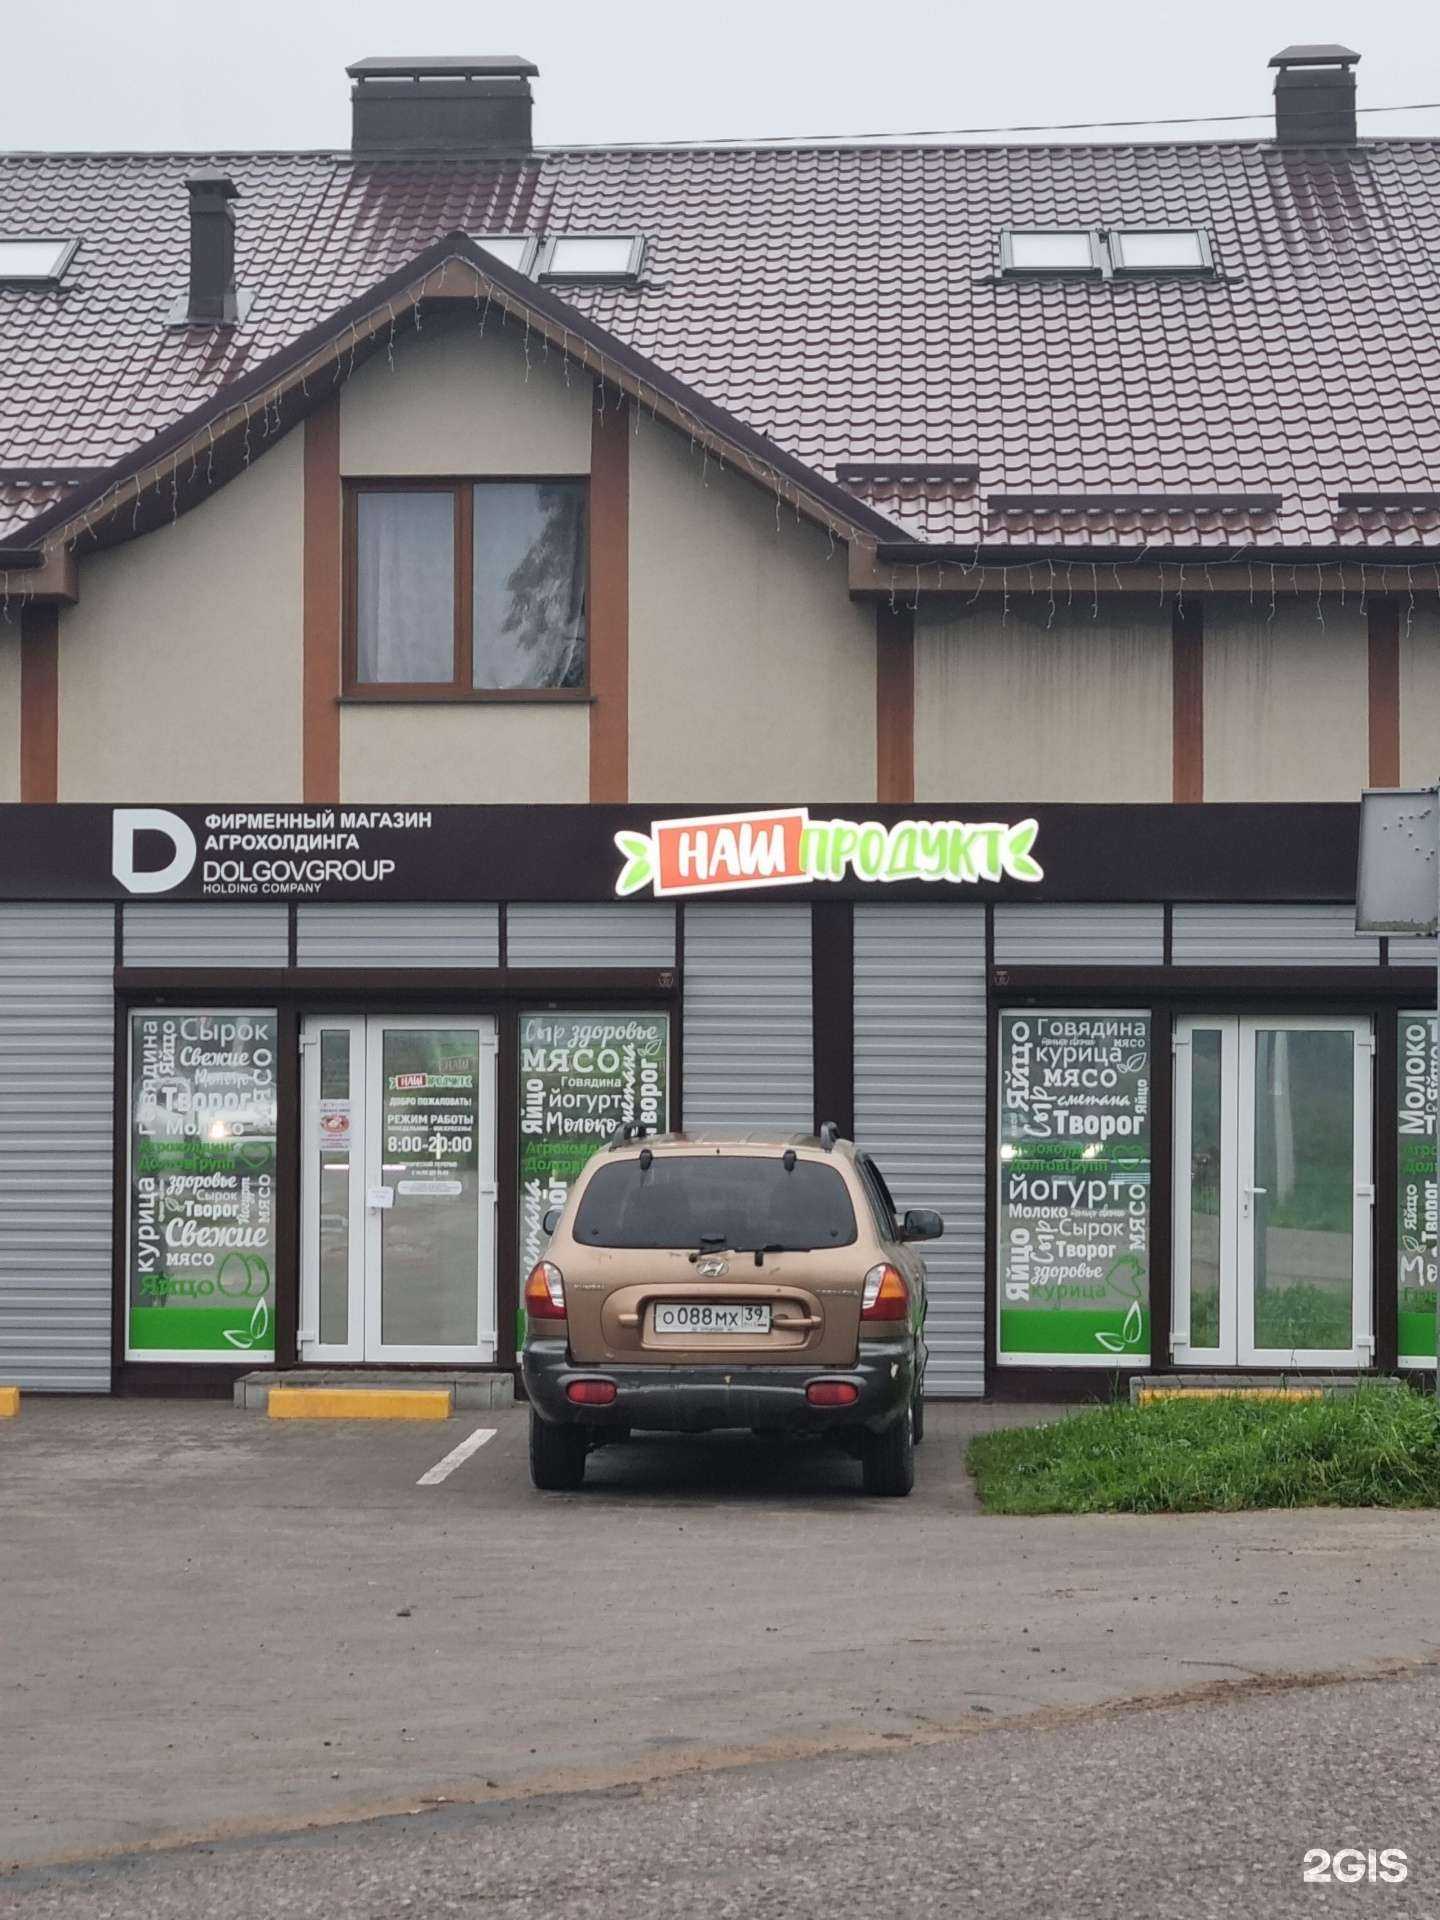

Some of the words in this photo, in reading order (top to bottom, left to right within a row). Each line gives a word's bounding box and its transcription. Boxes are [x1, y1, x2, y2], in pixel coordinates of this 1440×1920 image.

[205, 809, 335, 829] ФИРМЕННЫЙ
[340, 811, 432, 829] МАГАЗИН
[204, 834, 360, 853] АГРОХОЛДИНГА
[677, 822, 787, 881] НАШ
[799, 819, 1009, 883] ПРОДУКТ
[203, 859, 396, 883] DOLGOVGROUP
[203, 883, 259, 894] HOLDING
[262, 883, 322, 894] COMPANY
[180, 1018, 269, 1047] Сырок
[526, 1019, 565, 1046] Сыр
[567, 1021, 658, 1048] здоровье
[1037, 1019, 1146, 1039] Говядина
[1114, 1038, 1146, 1048] мясо
[180, 1046, 250, 1067] Свежие
[1004, 1021, 1033, 1112] Яйцо
[1036, 1046, 1122, 1068] курица
[561, 1076, 621, 1088] Говядина
[621, 1041, 637, 1125] метана
[1399, 1024, 1427, 1134] Молоко
[162, 1086, 252, 1113] Творог
[520, 1078, 546, 1134] Яйцо
[549, 1088, 622, 1113] йогурт
[641, 1058, 662, 1135] ворог
[1057, 1094, 1131, 1107] сметана
[1134, 1078, 1149, 1115] Яйцо
[387, 1114, 428, 1125] РЕЖИМ
[430, 1114, 474, 1125] РАБОТЫ
[1023, 1085, 1057, 1137] Сыр
[546, 1111, 620, 1138] Молоко
[1053, 1110, 1145, 1141] Творог
[387, 1136, 473, 1153] 8:00-20:00
[167, 1172, 238, 1195] здоровье
[196, 1189, 237, 1203] Сырок
[1009, 1173, 1125, 1209] йогурт
[184, 1200, 240, 1220] Творог
[258, 1174, 271, 1224] мясо
[1008, 1203, 1068, 1218] Молоко
[1403, 1183, 1419, 1230] Яйцо
[138, 1177, 160, 1272] курица
[1059, 1218, 1125, 1241] Сырок
[1128, 1184, 1147, 1252] мясо
[165, 1217, 269, 1247] Свежие
[1030, 1219, 1059, 1263] Сыр
[166, 1252, 215, 1266] мясо
[1056, 1240, 1116, 1261] Творог
[1006, 1228, 1033, 1301] Яйцо
[1030, 1263, 1104, 1285] здоровье
[139, 1275, 215, 1298] Яйцо
